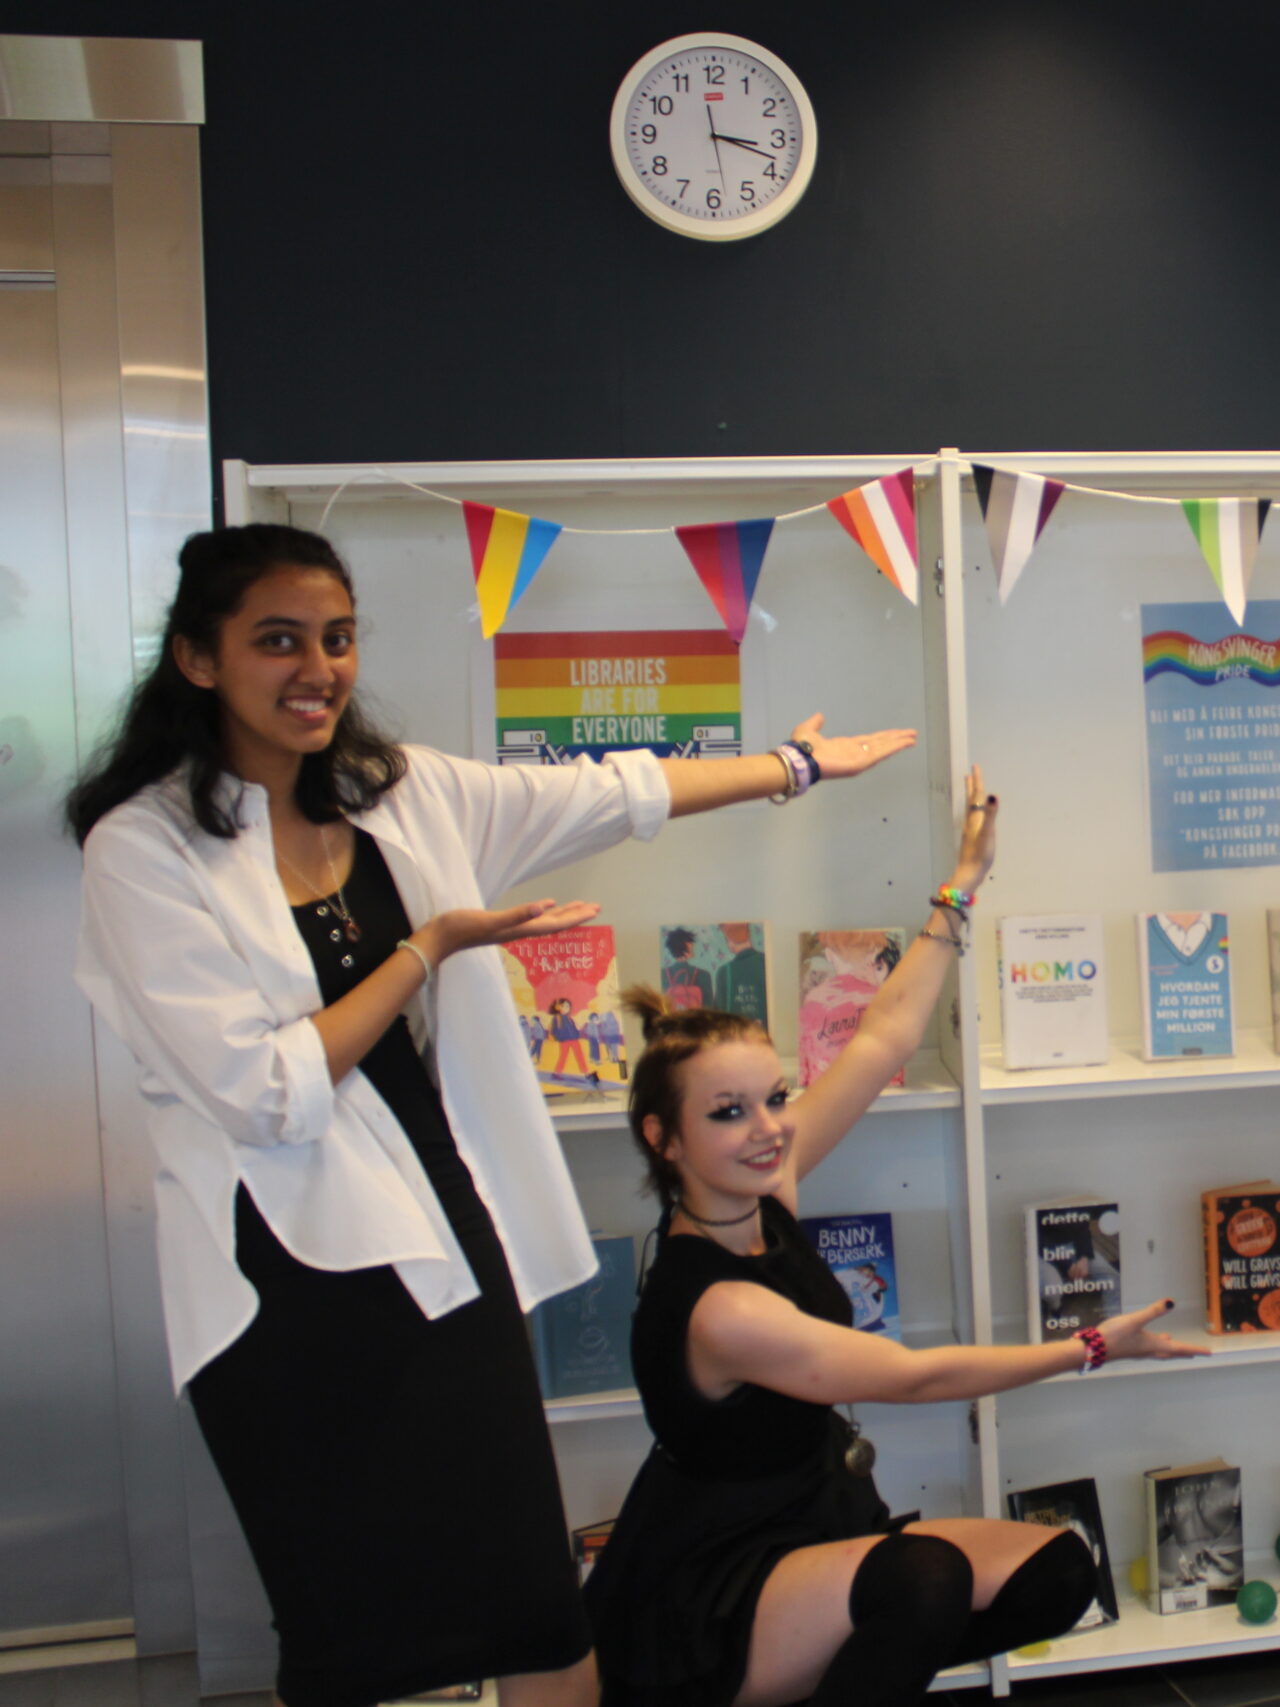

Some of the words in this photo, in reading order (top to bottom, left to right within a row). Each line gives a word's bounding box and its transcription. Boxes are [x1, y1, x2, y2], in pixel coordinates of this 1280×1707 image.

[672, 73, 690, 93] 11
[703, 65, 725, 85] 12
[740, 76, 749, 95] 1
[648, 95, 674, 116] 10
[762, 98, 777, 118] 2
[641, 124, 657, 144] 9
[770, 129, 786, 149] 3
[652, 155, 668, 176] 8
[762, 161, 777, 181] 4
[676, 179, 690, 198] 7
[740, 181, 755, 201] 5
[706, 188, 721, 209] 6
[1188, 636, 1276, 670] KONGSVINGER
[571, 658, 667, 686] LIBRARIES
[1215, 663, 1252, 682] PRIDE
[580, 687, 616, 715] ARE
[622, 686, 660, 714] FOR
[1172, 708, 1196, 722] MED
[1200, 704, 1208, 721] Å
[572, 715, 667, 744] EVERYONE
[1185, 727, 1204, 741] SIN
[1174, 791, 1194, 805] FOR
[1200, 790, 1221, 803] MER
[1244, 806, 1265, 820] OPP
[1011, 960, 1098, 985] HOMO
[1160, 981, 1219, 993] HVORDAN
[1159, 996, 1180, 1007] JEG
[1182, 994, 1223, 1006] TJENTE
[1156, 1010, 1179, 1020] MIN
[1183, 1008, 1225, 1019] FØRSTE
[1166, 1022, 1216, 1033] MILLION
[1041, 1212, 1091, 1227] dette
[1043, 1246, 1076, 1263] blir
[1223, 1260, 1248, 1274] WILL
[1044, 1276, 1115, 1297] mellom
[1223, 1274, 1248, 1290] WILL
[1046, 1315, 1081, 1330] oss
